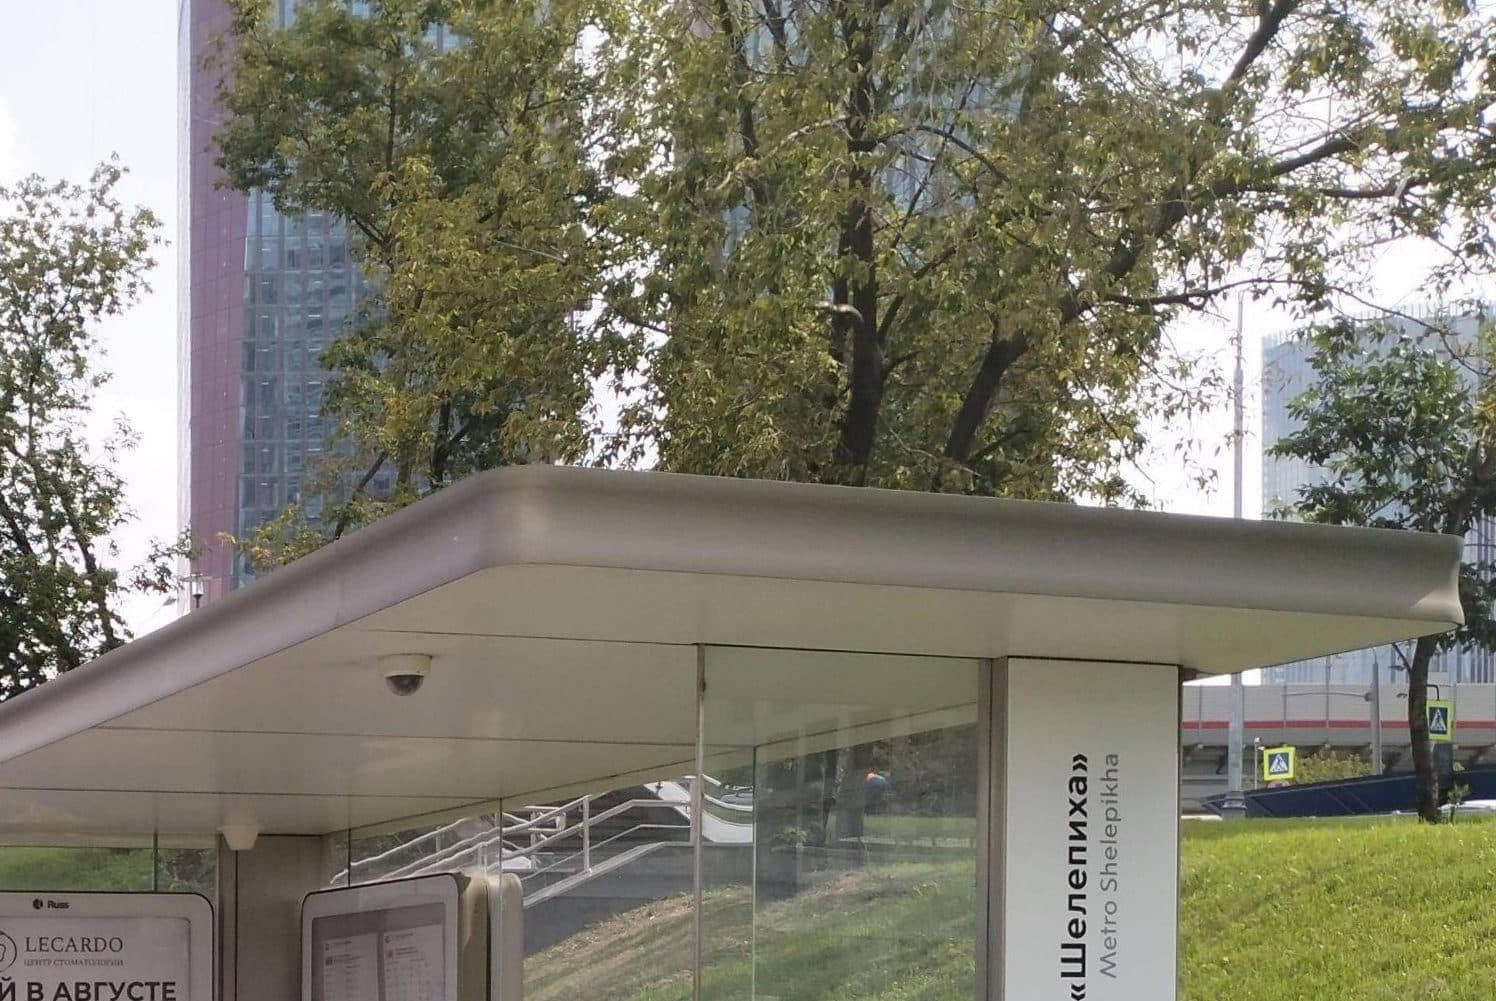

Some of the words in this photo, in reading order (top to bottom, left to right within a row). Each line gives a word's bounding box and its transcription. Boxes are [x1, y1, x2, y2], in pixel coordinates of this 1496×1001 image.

[1099, 752, 1122, 893] Shelepikha
[47, 900, 70, 910] Russ
[24, 936, 124, 953] LECARDO
[1099, 900, 1118, 979] Metro
[27, 981, 44, 1001] В
[52, 981, 177, 1001] АВГУСТЕ
